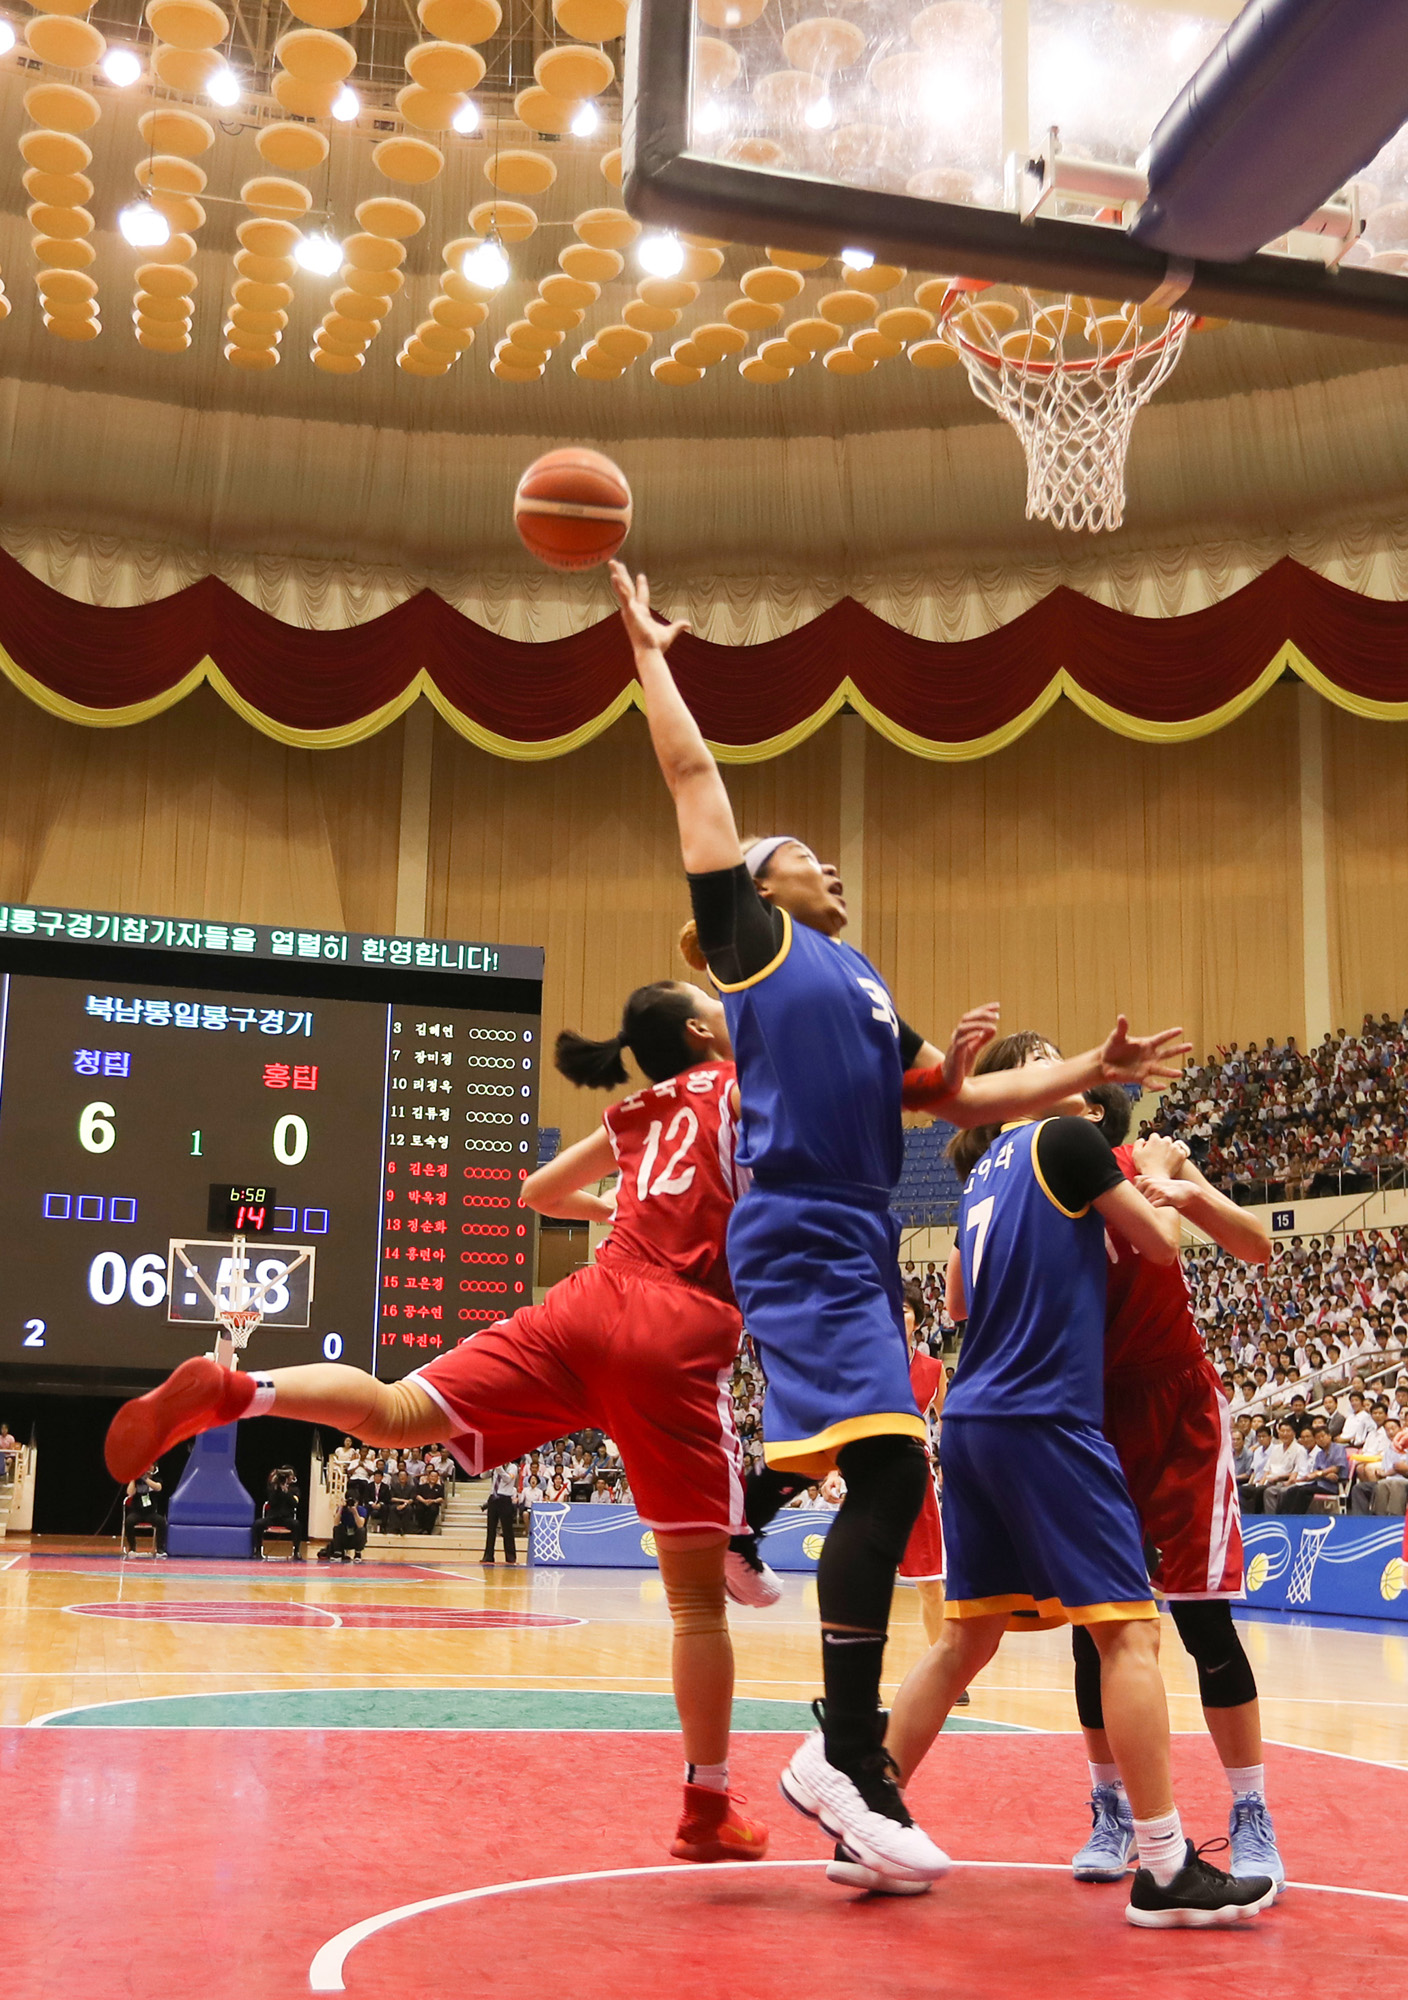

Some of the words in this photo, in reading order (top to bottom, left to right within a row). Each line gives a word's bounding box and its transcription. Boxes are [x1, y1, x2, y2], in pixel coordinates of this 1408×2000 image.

[270, 930, 348, 961] 열렬히
[361, 938, 499, 972] 환영합니다!
[85, 994, 313, 1037] 북남통일롱구경기
[393, 1022, 402, 1033] 3
[523, 1031, 533, 1042] 0
[73, 1049, 131, 1078] 청팀
[392, 1050, 401, 1061] 7
[522, 1058, 532, 1070] 0
[262, 1062, 319, 1091] 홍팀
[392, 1078, 407, 1089] 10
[521, 1086, 531, 1097] 0
[391, 1106, 405, 1117] 11
[520, 1113, 529, 1125] 0
[78, 1101, 117, 1153] 6
[190, 1129, 203, 1156] 1
[273, 1114, 309, 1166] 0
[390, 1134, 405, 1145] 12
[519, 1141, 528, 1152] 0
[637, 1106, 698, 1201] 12
[388, 1162, 396, 1173] 6
[519, 1169, 528, 1180] 0
[386, 1190, 395, 1201] 9
[236, 1206, 265, 1230] 14
[386, 1219, 402, 1230] 13
[516, 1225, 526, 1236] 0
[1277, 1214, 1289, 1227] 15
[966, 1195, 995, 1288] 7
[385, 1247, 400, 1259] 14
[516, 1253, 525, 1265] 0
[88, 1251, 290, 1314] 06:58
[384, 1276, 399, 1287] 15
[514, 1282, 524, 1293] 0
[383, 1305, 398, 1316] 16
[23, 1319, 46, 1347] 2
[381, 1334, 397, 1345] 17
[323, 1333, 343, 1360] 0
